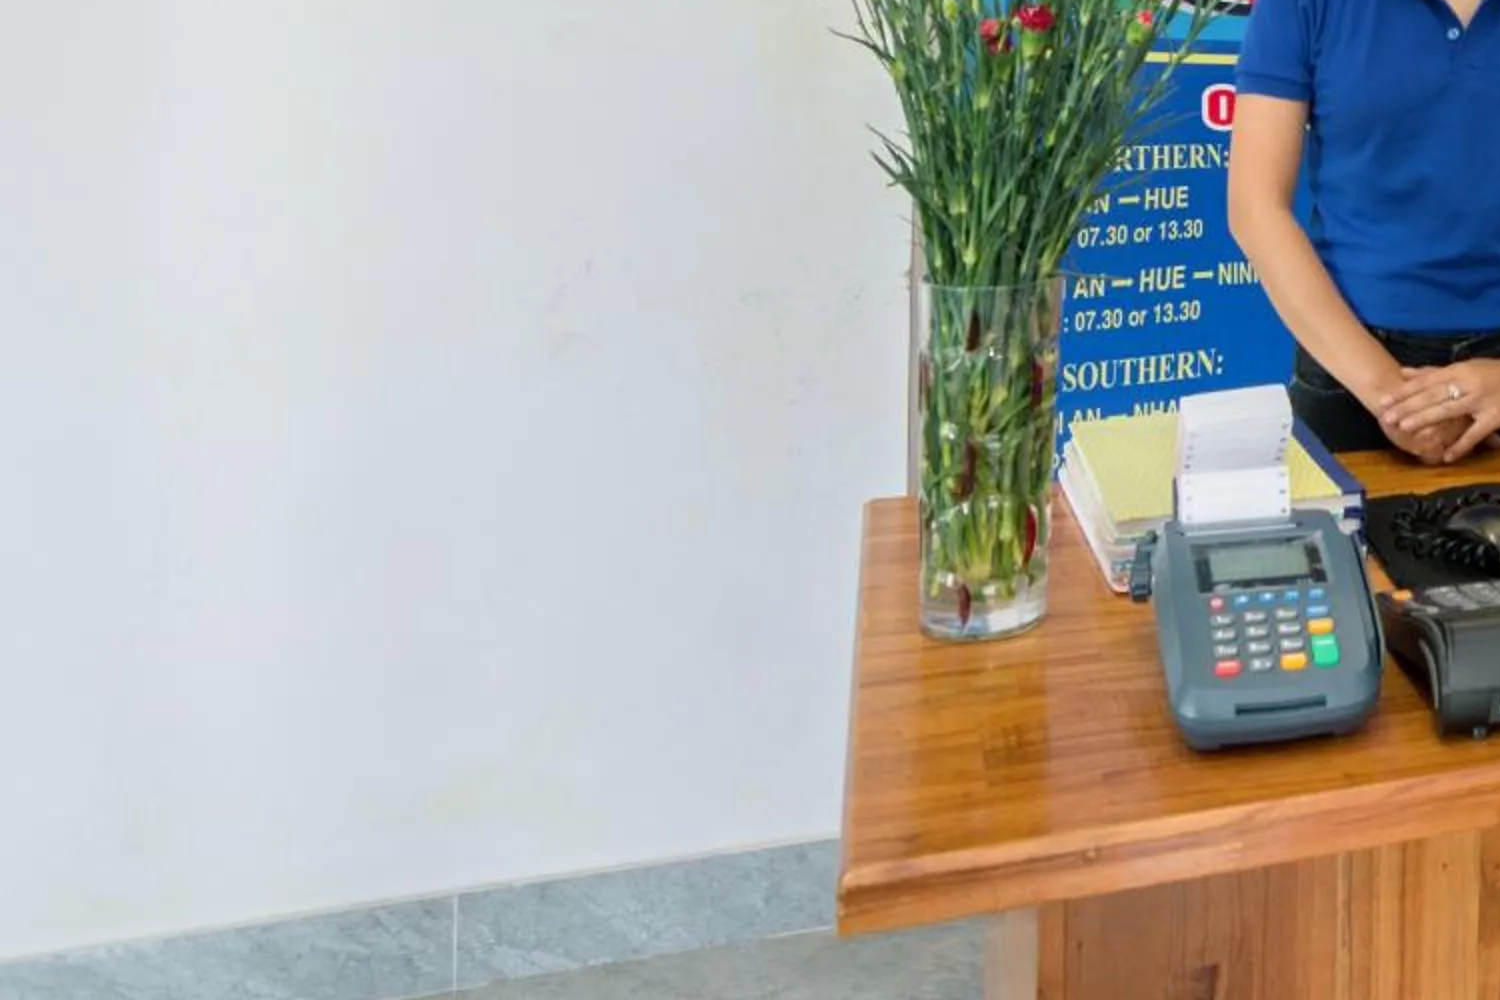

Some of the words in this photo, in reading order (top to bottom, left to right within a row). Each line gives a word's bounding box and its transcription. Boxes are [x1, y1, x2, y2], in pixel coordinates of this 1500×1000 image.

[1112, 143, 1230, 172] RTHERN:
[1144, 185, 1189, 210] HUE
[1077, 225, 1128, 248] 07.30
[1133, 227, 1152, 242] or
[1159, 219, 1203, 240] 13.30
[1073, 276, 1105, 299] AN
[1139, 265, 1186, 293] HUE
[1217, 261, 1259, 286] NIN
[1075, 308, 1123, 333] 07.30
[1128, 310, 1147, 326] or
[1153, 300, 1201, 324] 13.30
[1062, 348, 1224, 393] SOUTHERN:
